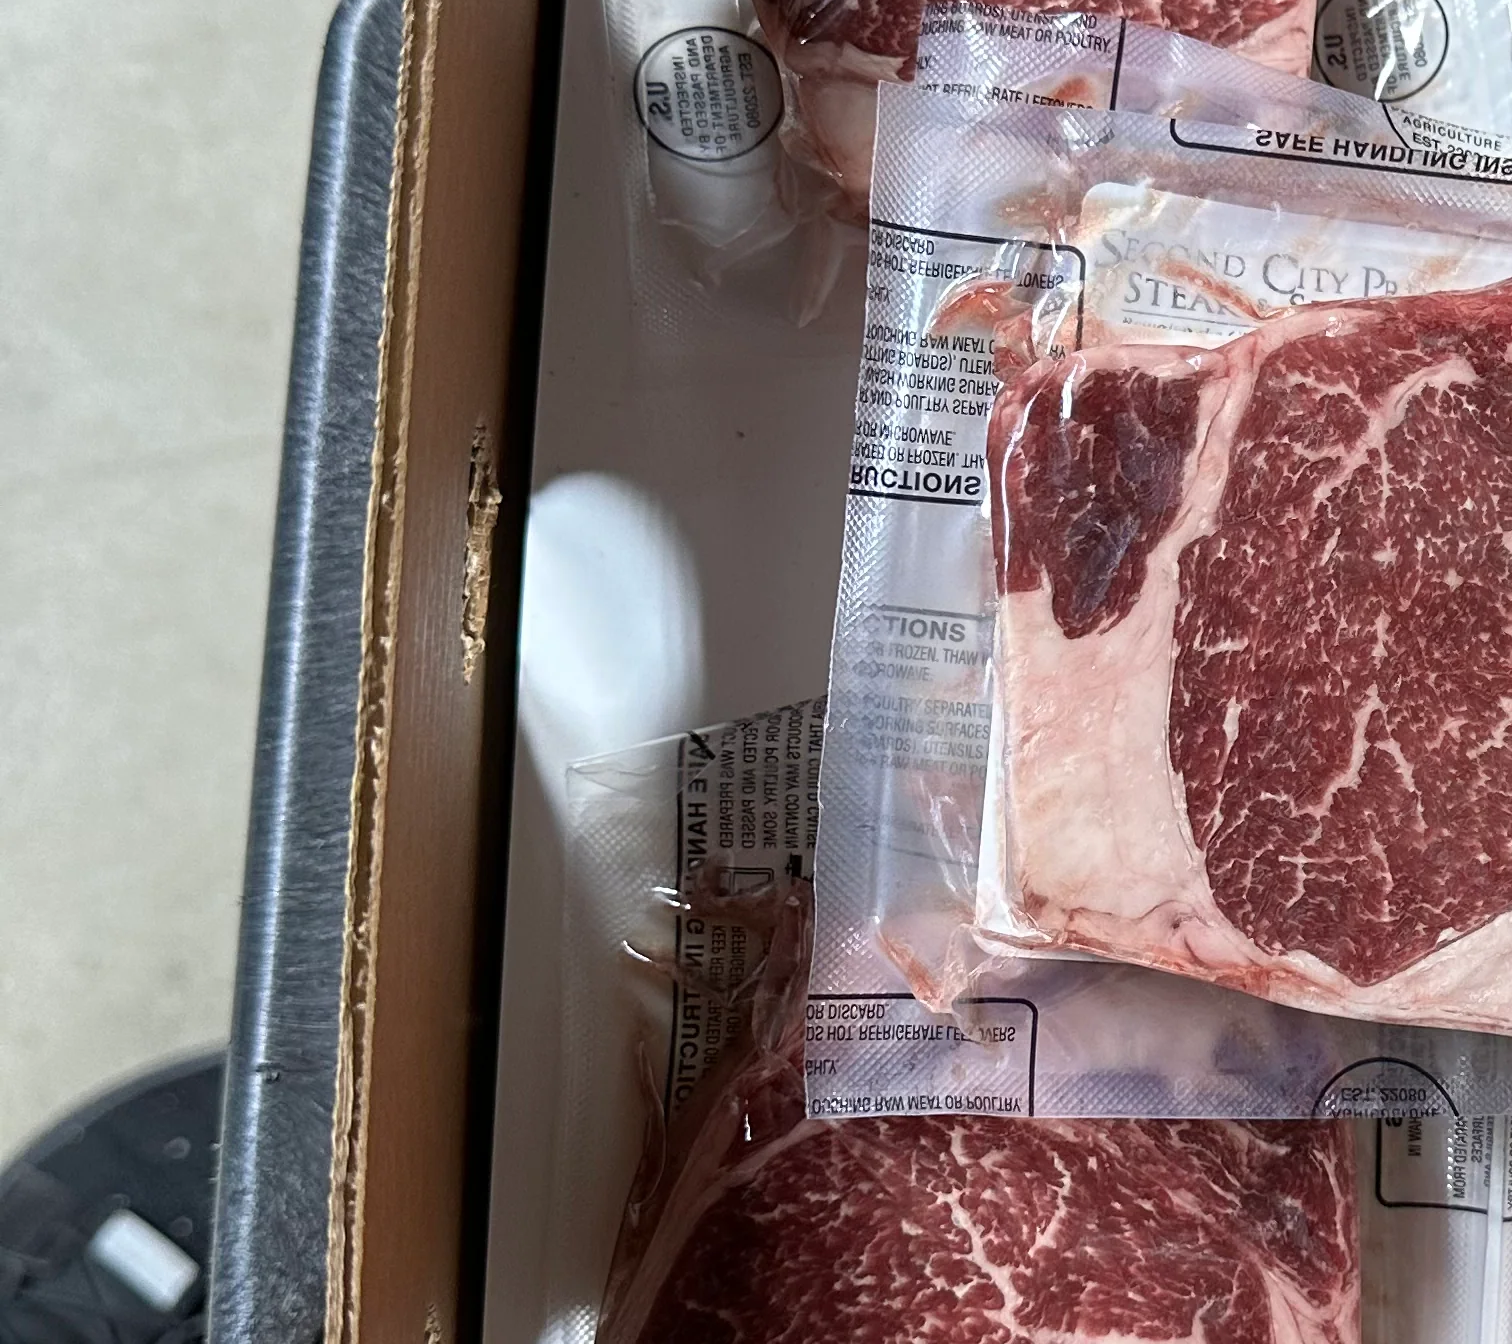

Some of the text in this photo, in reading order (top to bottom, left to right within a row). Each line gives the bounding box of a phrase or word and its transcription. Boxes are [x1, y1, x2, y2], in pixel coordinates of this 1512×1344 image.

[999, 24, 1031, 42] MEAT
[1035, 29, 1052, 43] OR
[1055, 30, 1112, 54] POULTRY.
[1401, 114, 1503, 152] AGRICULTURE
[1412, 132, 1444, 155] EST.
[1097, 228, 1247, 279] SECOND
[1262, 253, 1349, 295] CITY
[942, 647, 979, 666] THAW
[923, 742, 984, 760] UTENSILS
